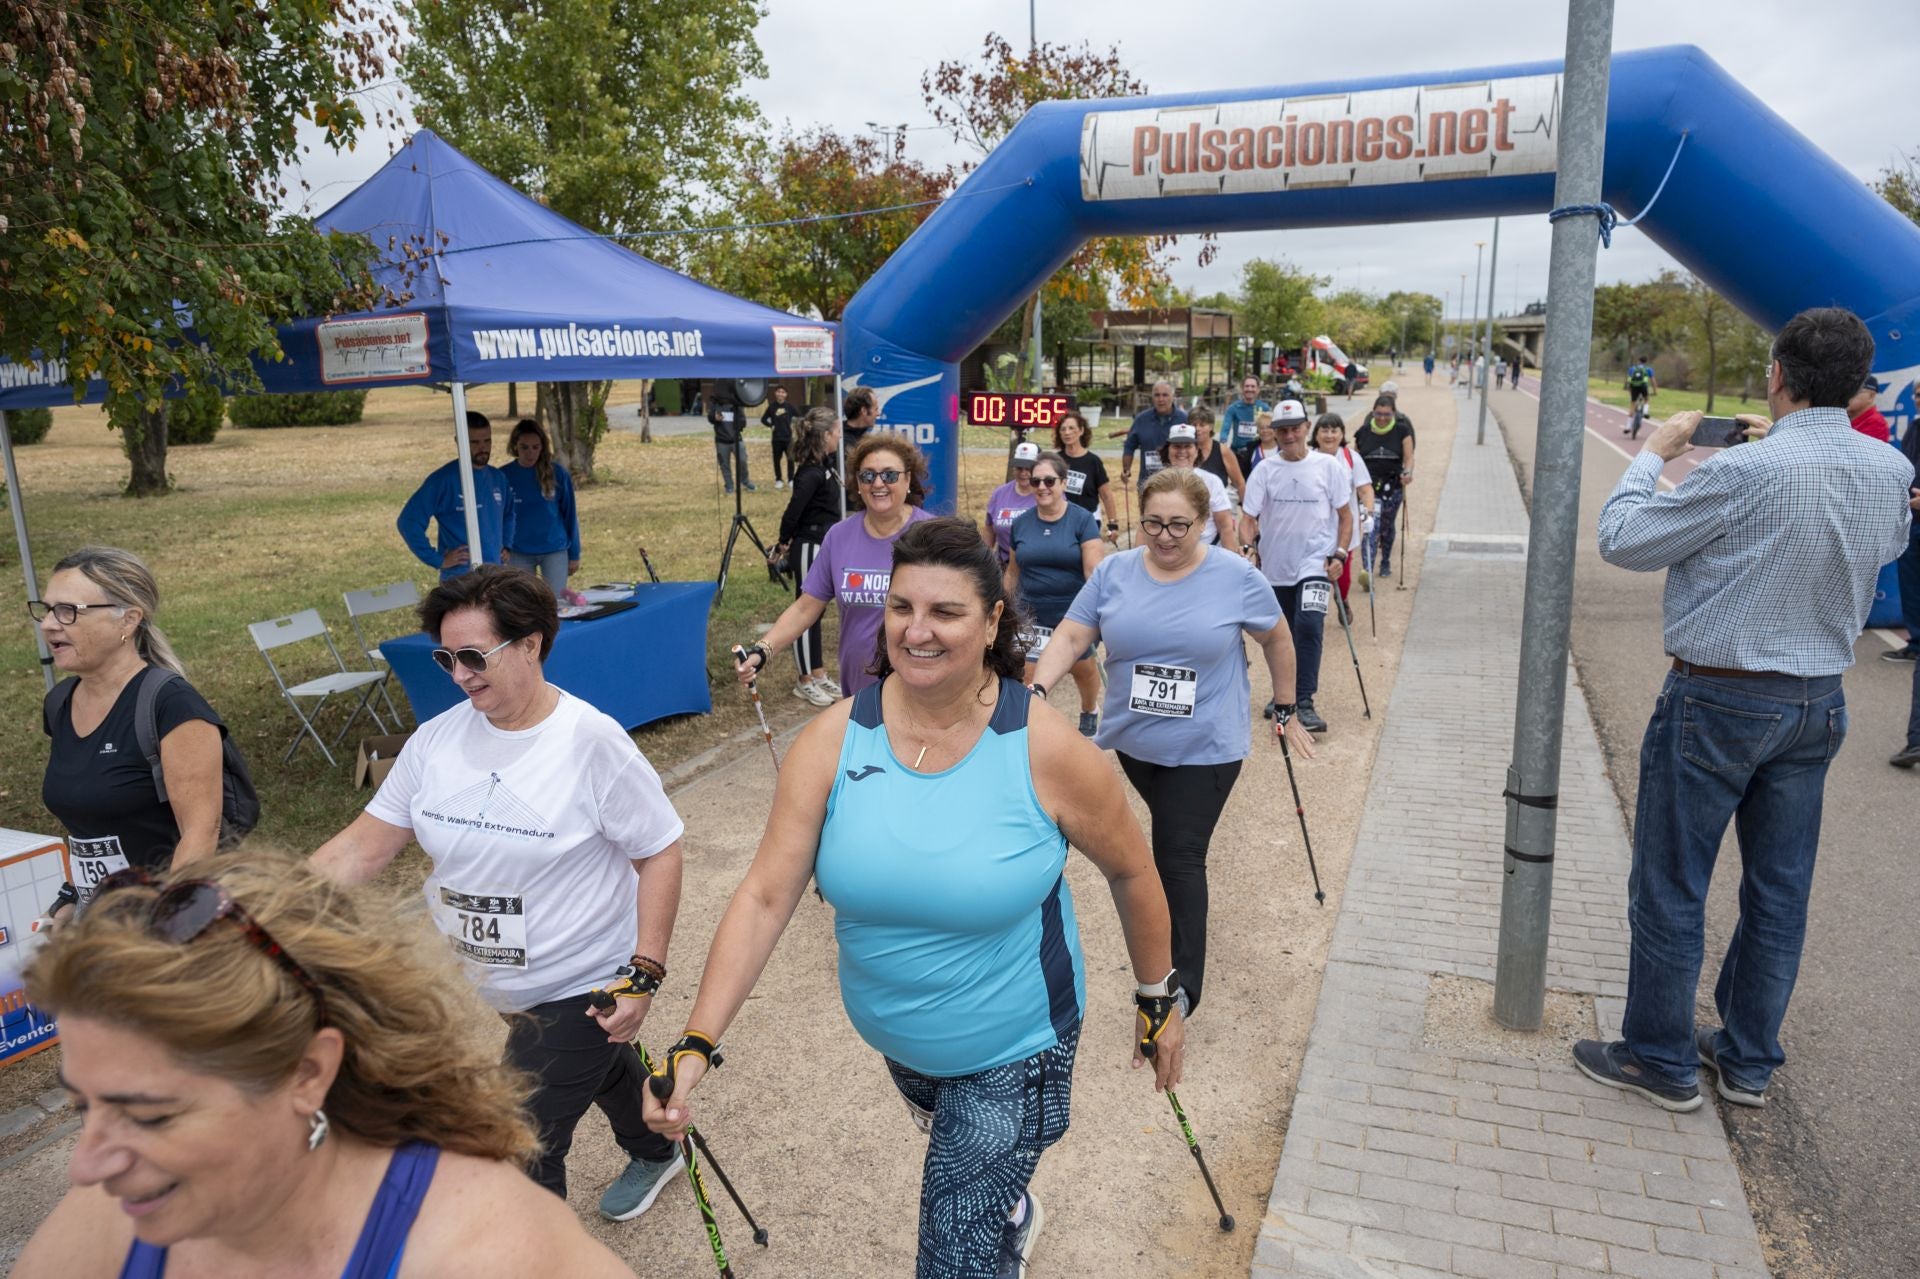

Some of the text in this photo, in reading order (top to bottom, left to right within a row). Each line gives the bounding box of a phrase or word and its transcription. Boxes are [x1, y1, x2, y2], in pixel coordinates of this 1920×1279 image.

[1132, 97, 1517, 177] Pulsaciones.net
[334, 332, 411, 348] Pulsaciones.net
[472, 322, 705, 361] www.pulsaciones.net
[841, 572, 849, 589] I
[1149, 679, 1178, 700] 791
[1156, 702, 1189, 711] EXTREMADURA
[422, 809, 445, 822] Nordic
[447, 816, 482, 828] Walking
[484, 822, 555, 838] Extremadura
[79, 861, 109, 884] 759
[458, 913, 501, 943] 784
[473, 946, 521, 958] EXTREMADURA
